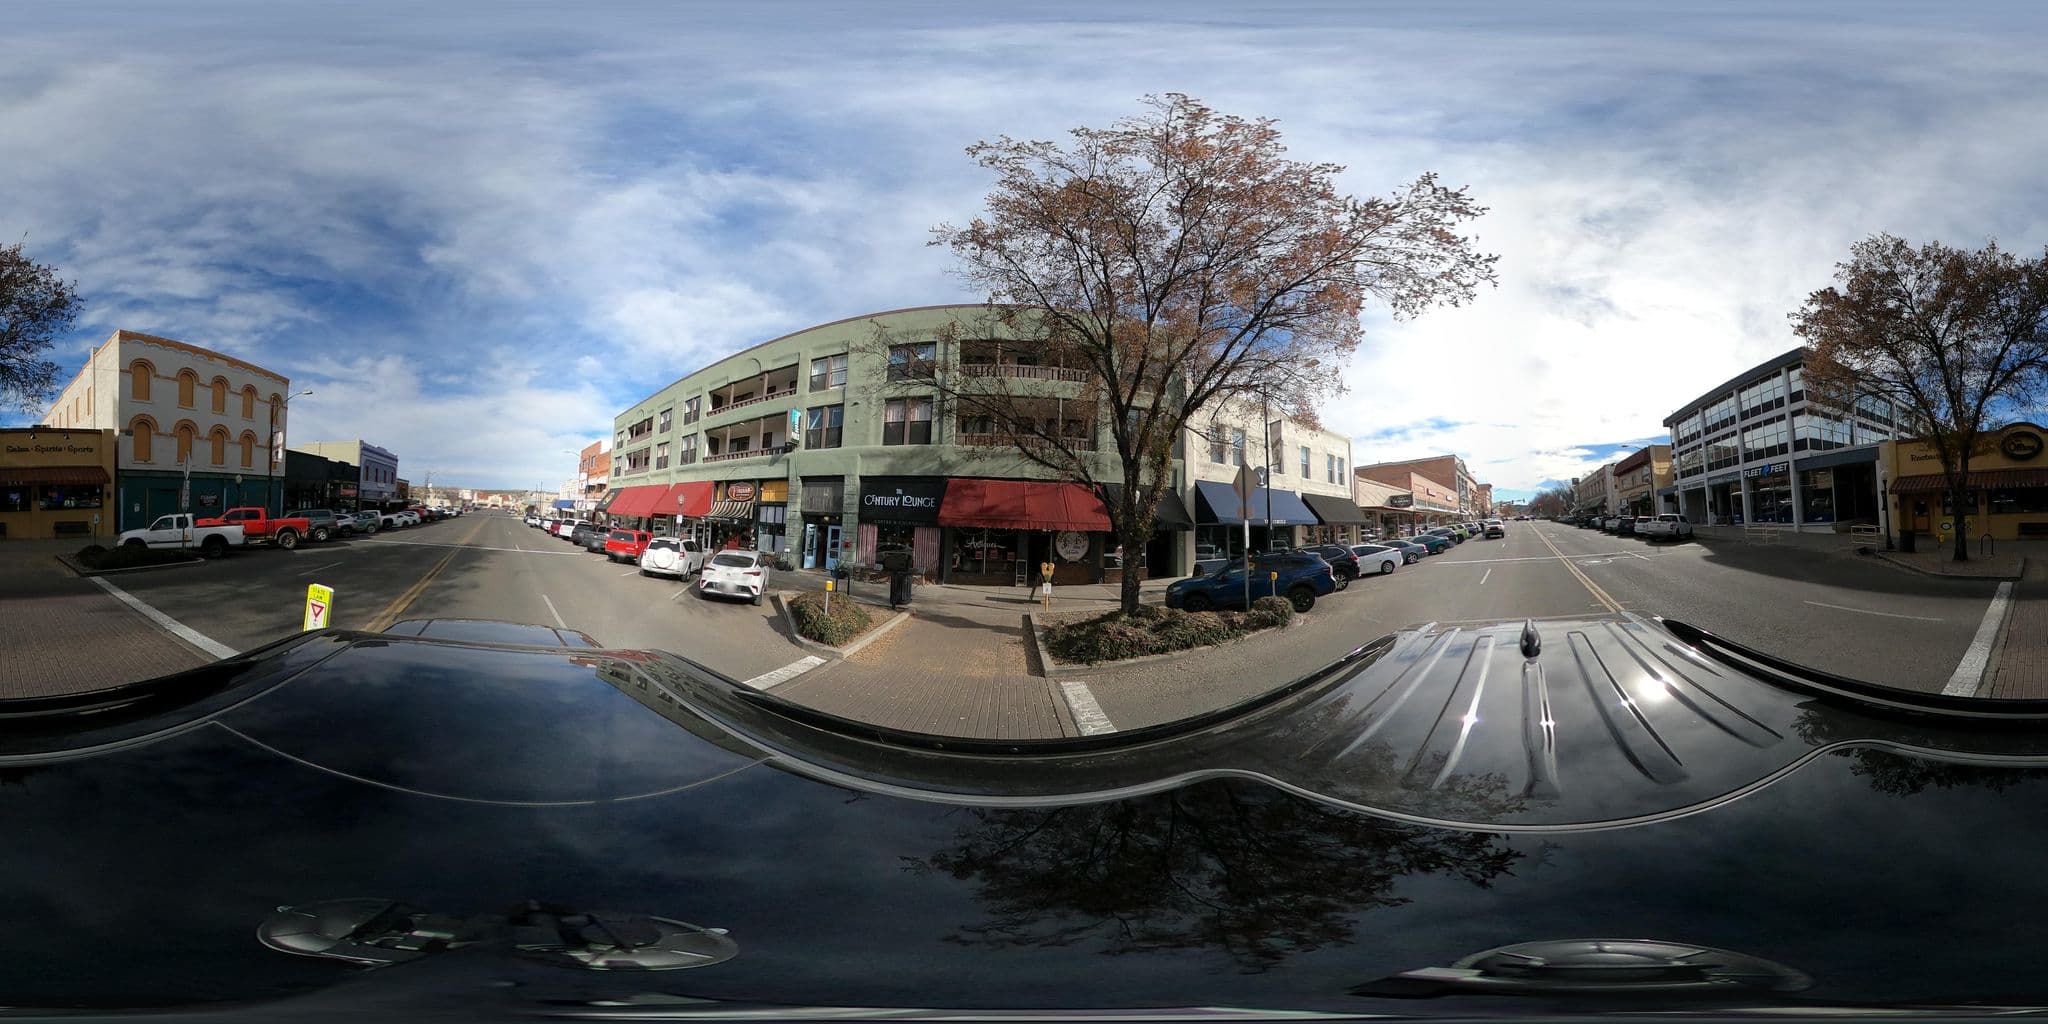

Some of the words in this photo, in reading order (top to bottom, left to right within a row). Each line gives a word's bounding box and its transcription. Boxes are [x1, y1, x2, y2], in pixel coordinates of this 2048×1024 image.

[68, 445, 93, 453] Sports
[1744, 468, 1762, 478] FLEET
[1770, 463, 1788, 472] FEET
[864, 494, 900, 506] CENTURY
[902, 495, 936, 508] LOUNGE
